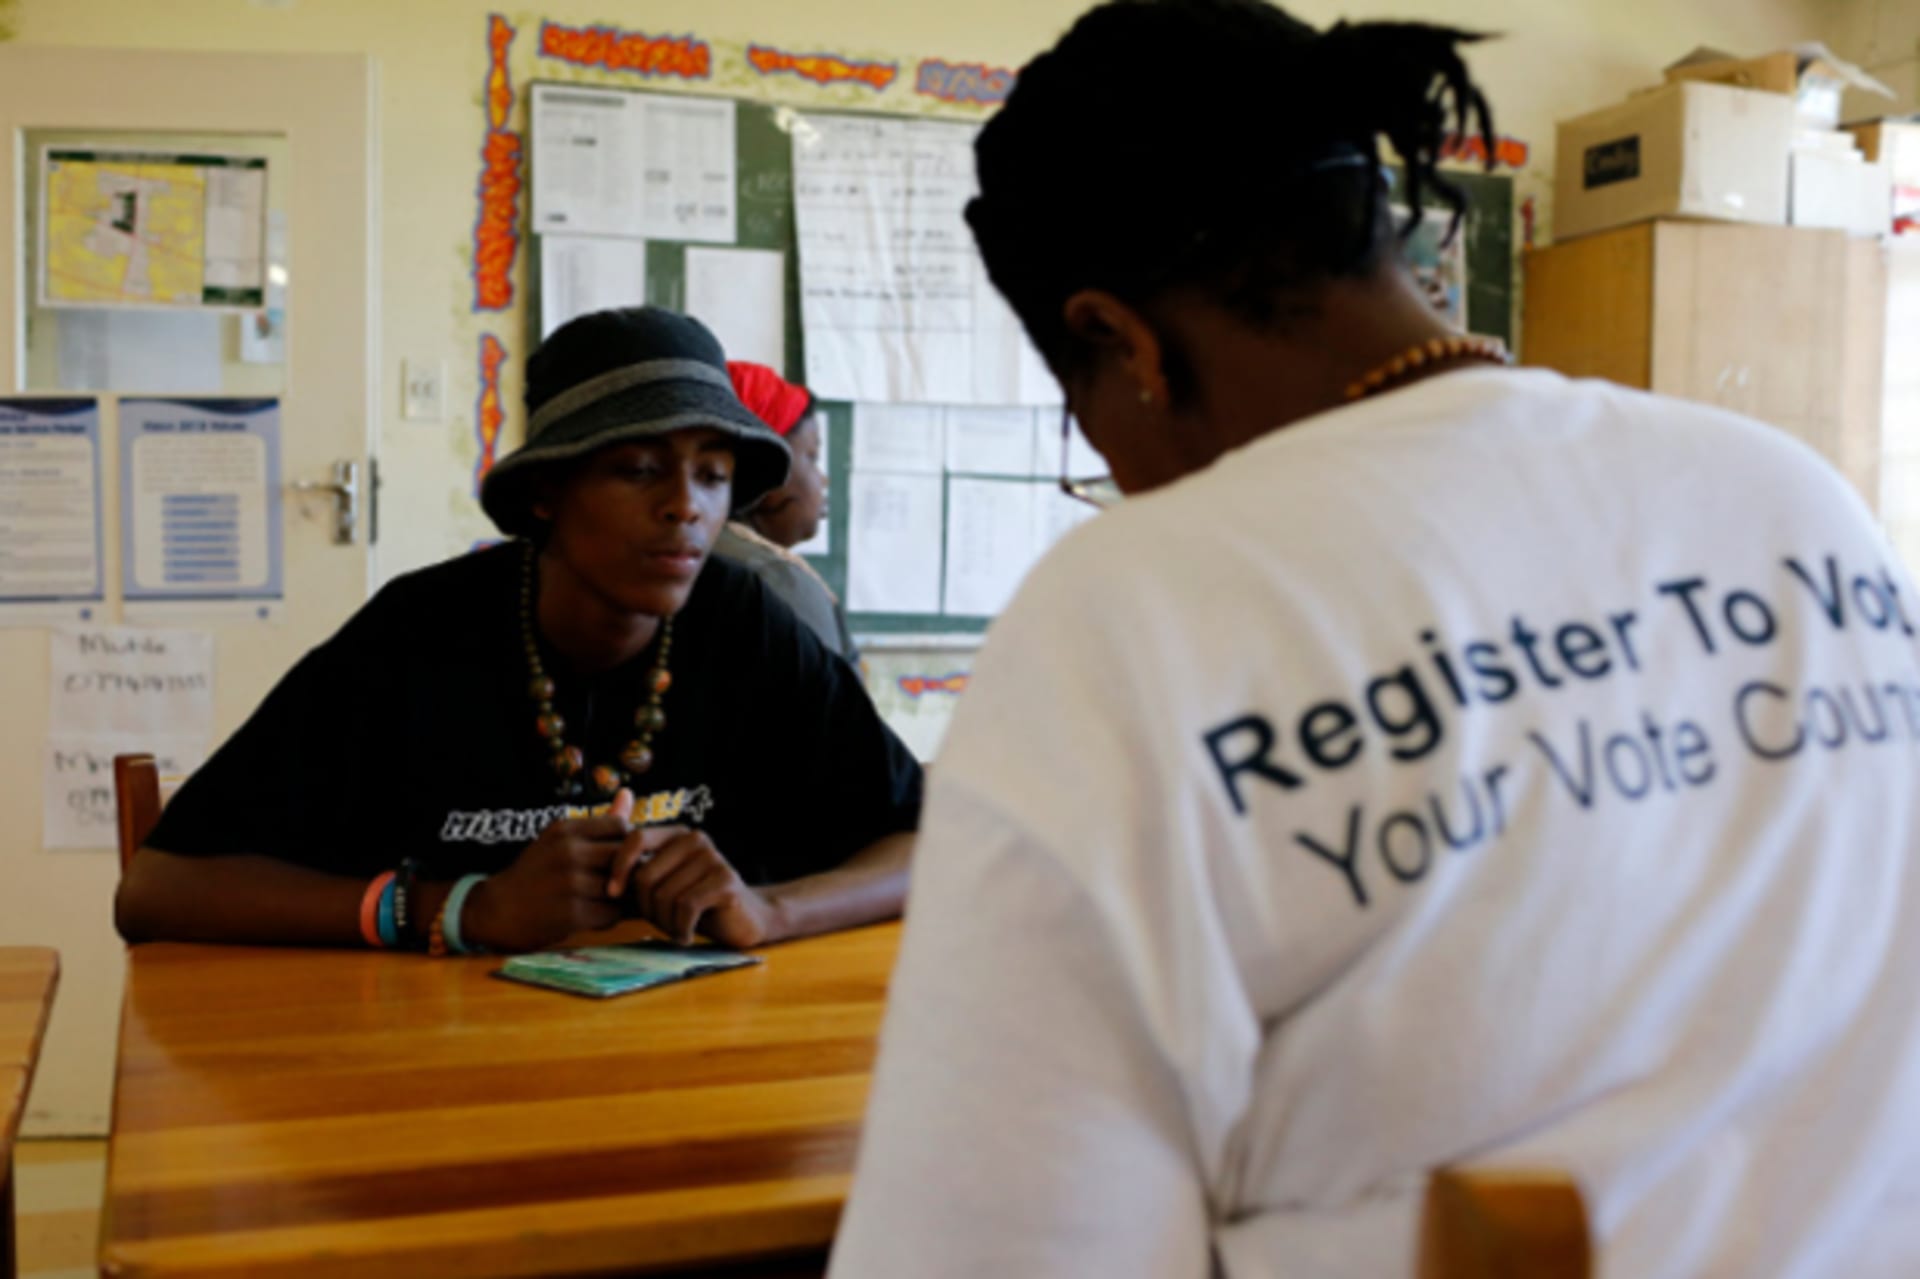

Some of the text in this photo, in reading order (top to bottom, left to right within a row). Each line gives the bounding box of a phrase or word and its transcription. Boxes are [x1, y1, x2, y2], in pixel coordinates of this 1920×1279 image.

[1202, 611, 1641, 817] Register
[1656, 577, 1778, 656] To
[1293, 764, 1508, 908] Your
[1528, 711, 1719, 811] Vote
